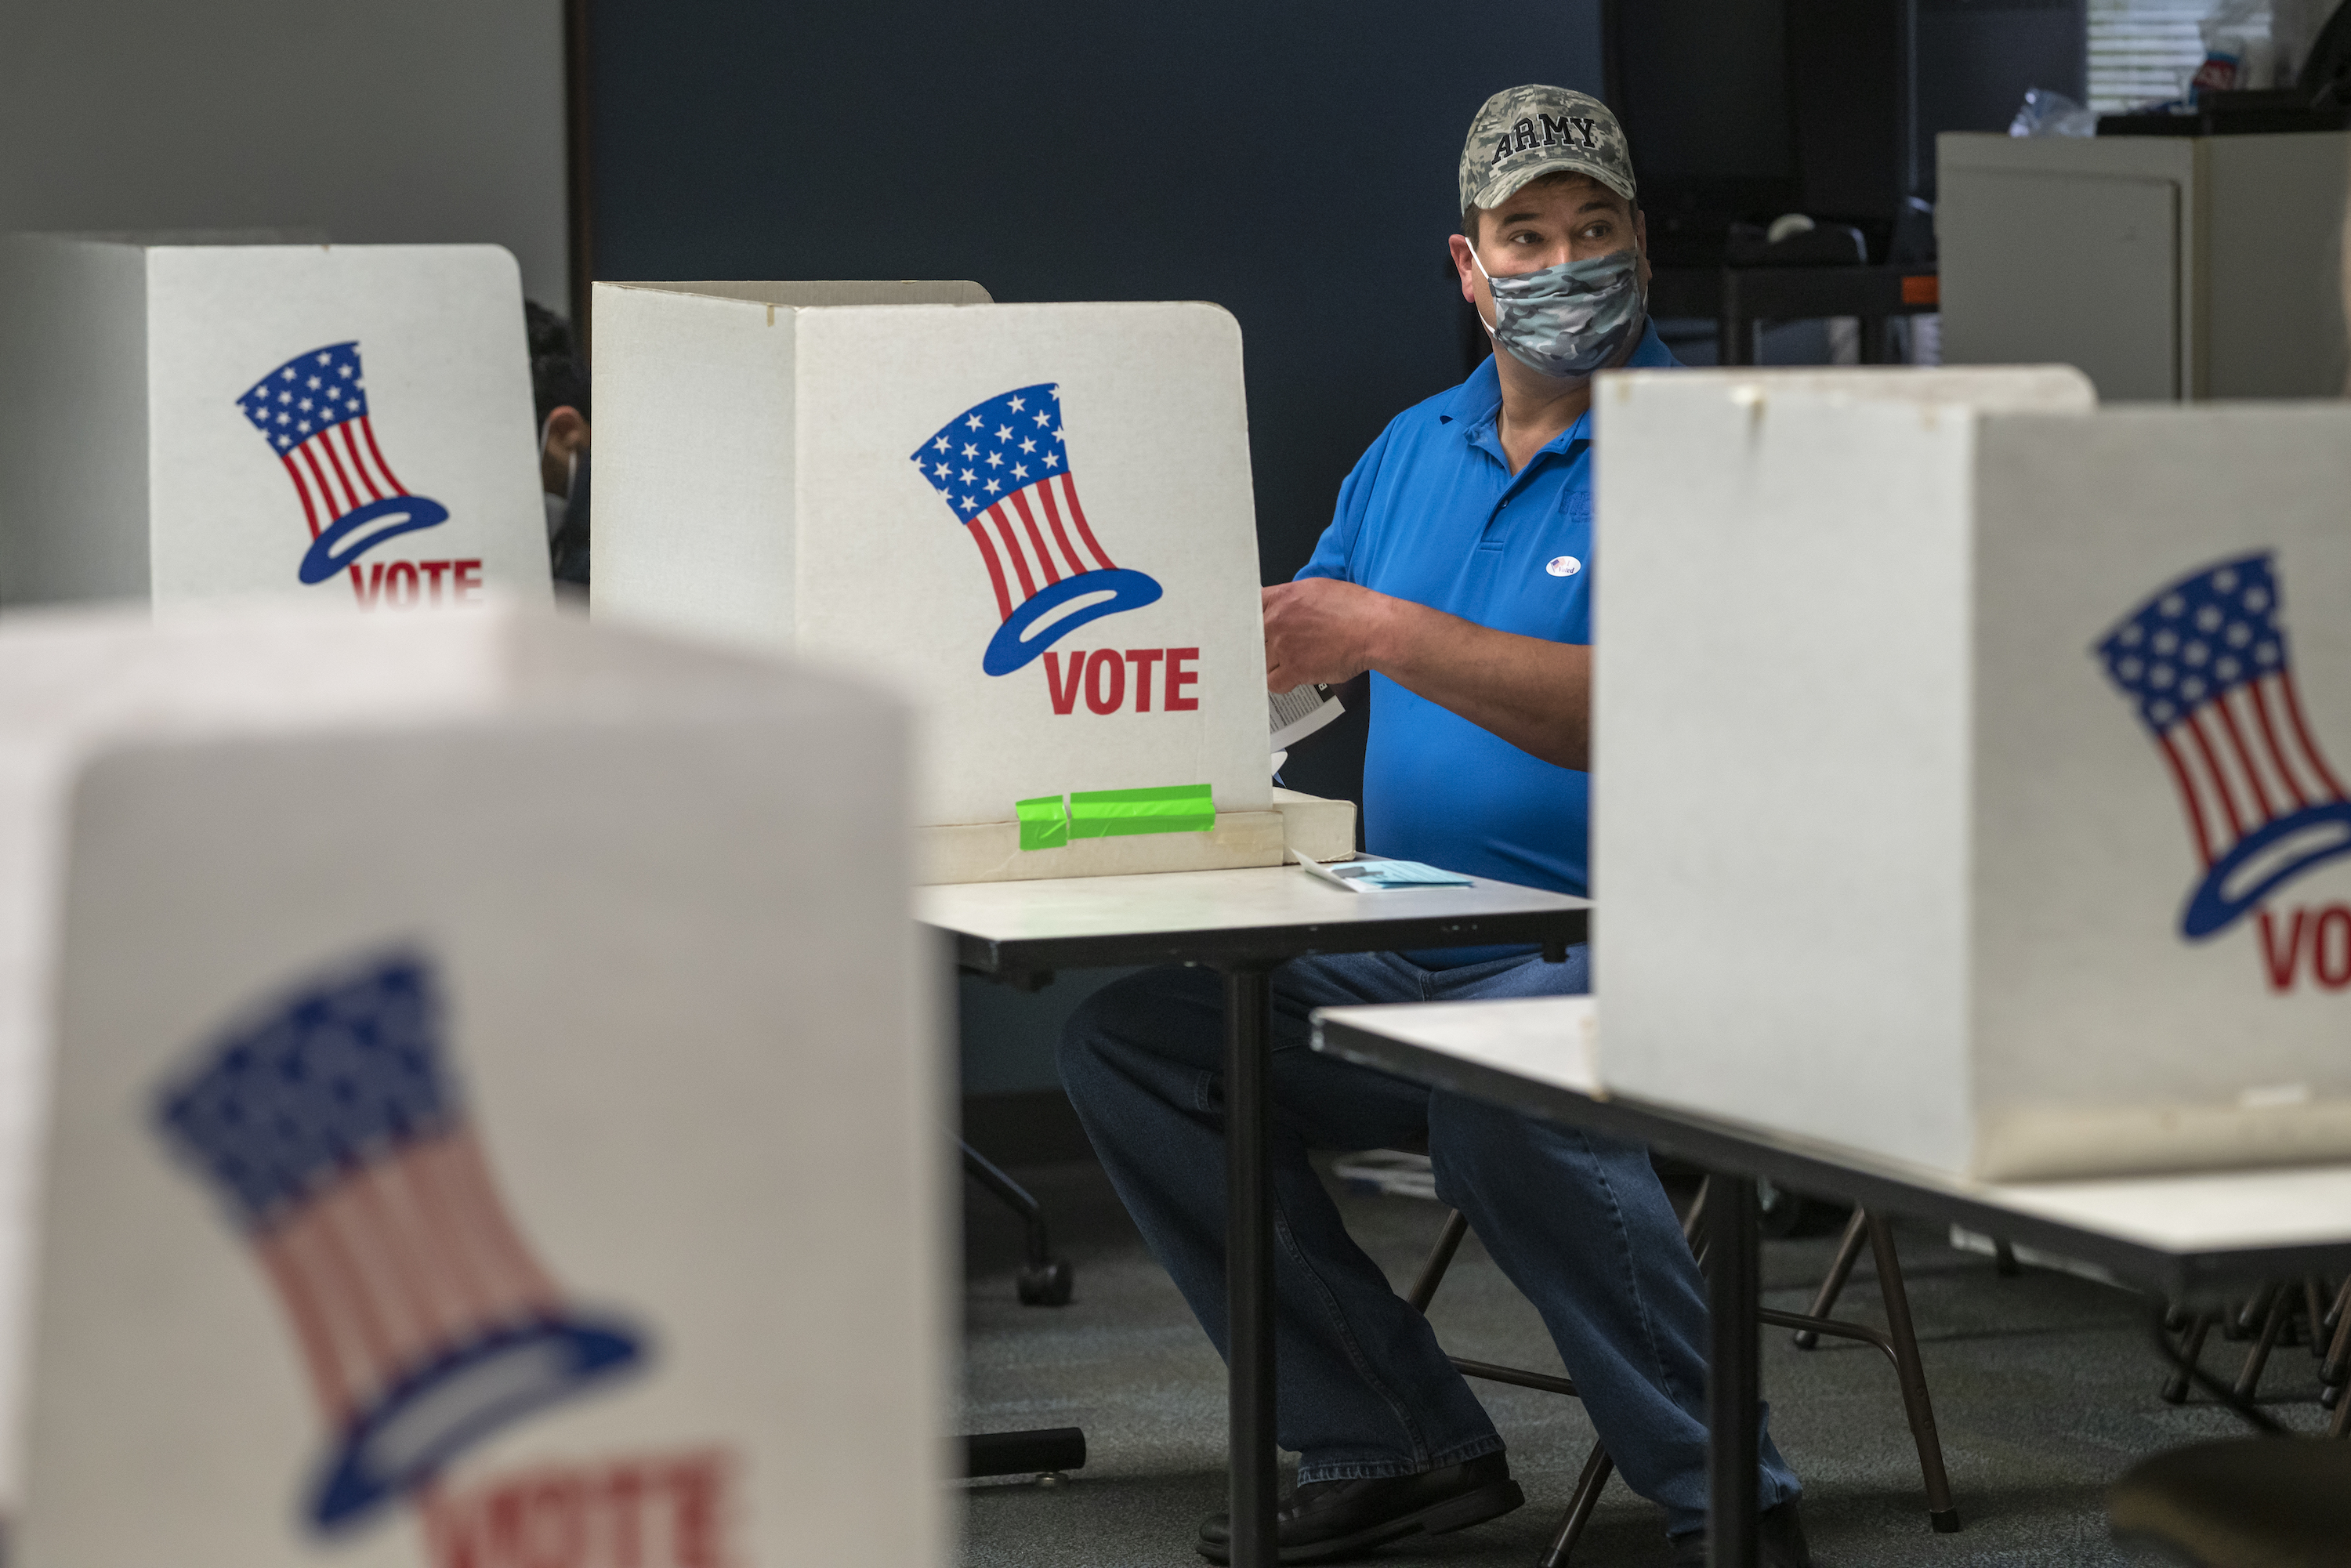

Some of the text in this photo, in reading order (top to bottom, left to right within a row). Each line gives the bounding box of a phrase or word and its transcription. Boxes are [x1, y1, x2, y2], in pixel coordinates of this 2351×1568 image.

[1491, 113, 1596, 165] ARMY
[349, 558, 483, 613] VOTE
[1043, 647, 1199, 715] VOTE
